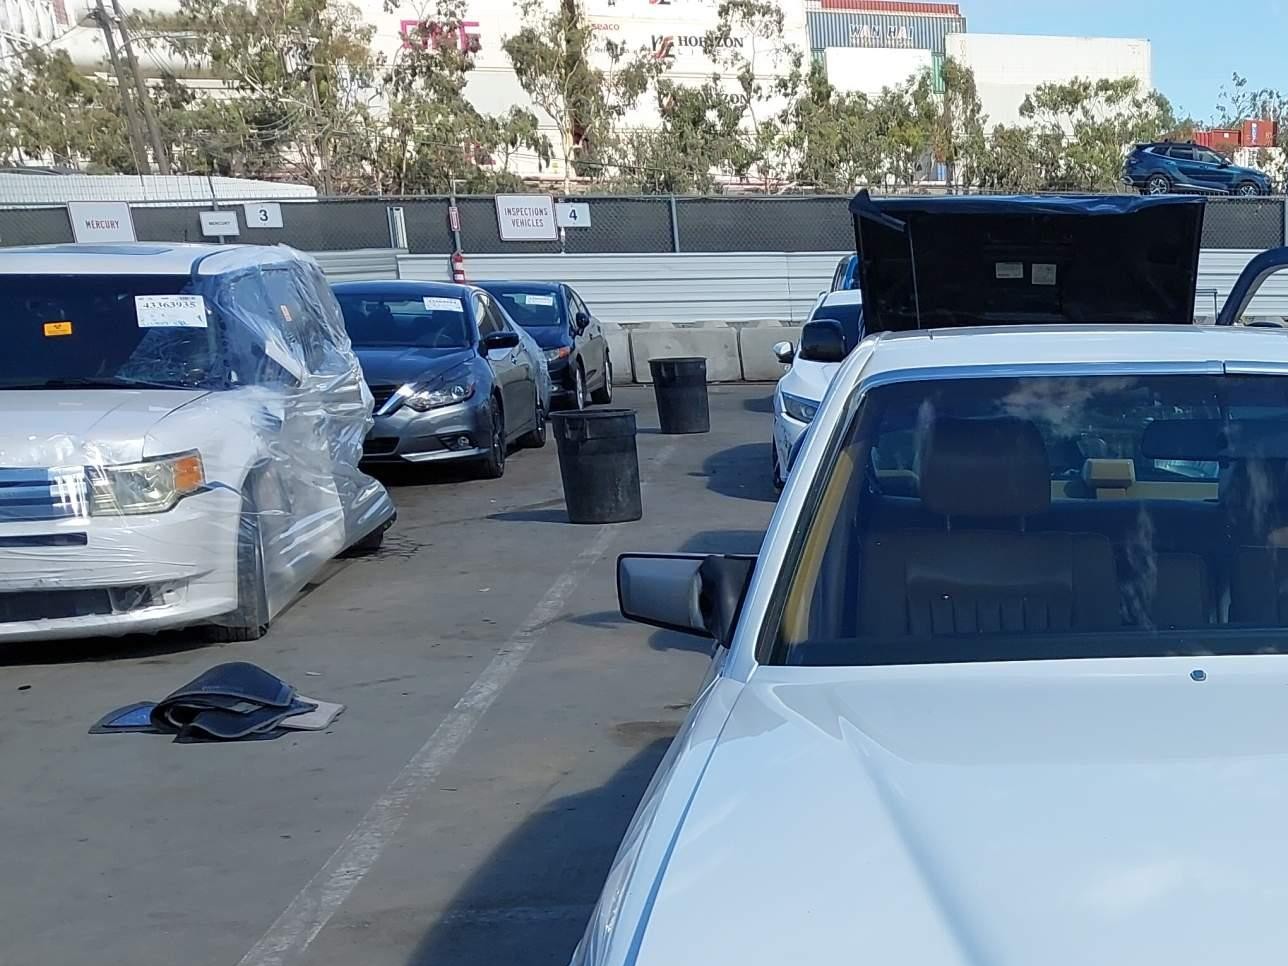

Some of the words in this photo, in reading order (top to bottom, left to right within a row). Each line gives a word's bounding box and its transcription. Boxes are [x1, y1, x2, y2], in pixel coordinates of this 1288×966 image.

[849, 23, 881, 38] WAN
[886, 25, 914, 39] HAI
[677, 35, 744, 48] HORZON
[259, 209, 269, 222] 3
[504, 207, 549, 216] INSPECTIONS
[569, 209, 578, 221] 4
[85, 219, 120, 230] MERCURY
[511, 218, 544, 228] VEHICLES
